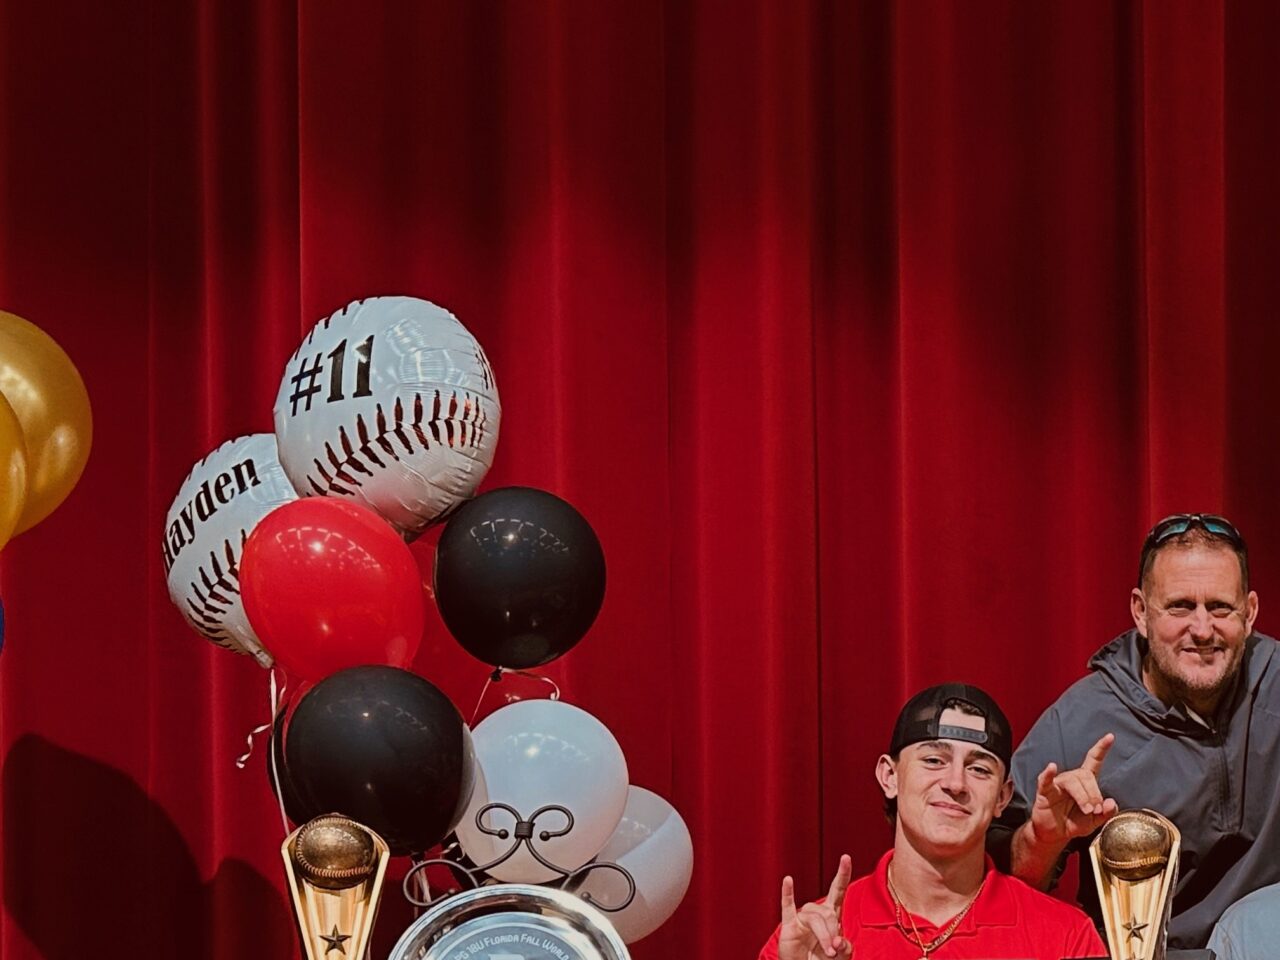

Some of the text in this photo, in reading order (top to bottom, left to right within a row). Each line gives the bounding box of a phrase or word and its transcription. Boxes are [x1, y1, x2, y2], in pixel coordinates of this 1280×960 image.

[290, 334, 375, 417] #11
[162, 457, 262, 580] Hayden
[466, 940, 485, 954] 18U
[520, 933, 540, 946] FALL
